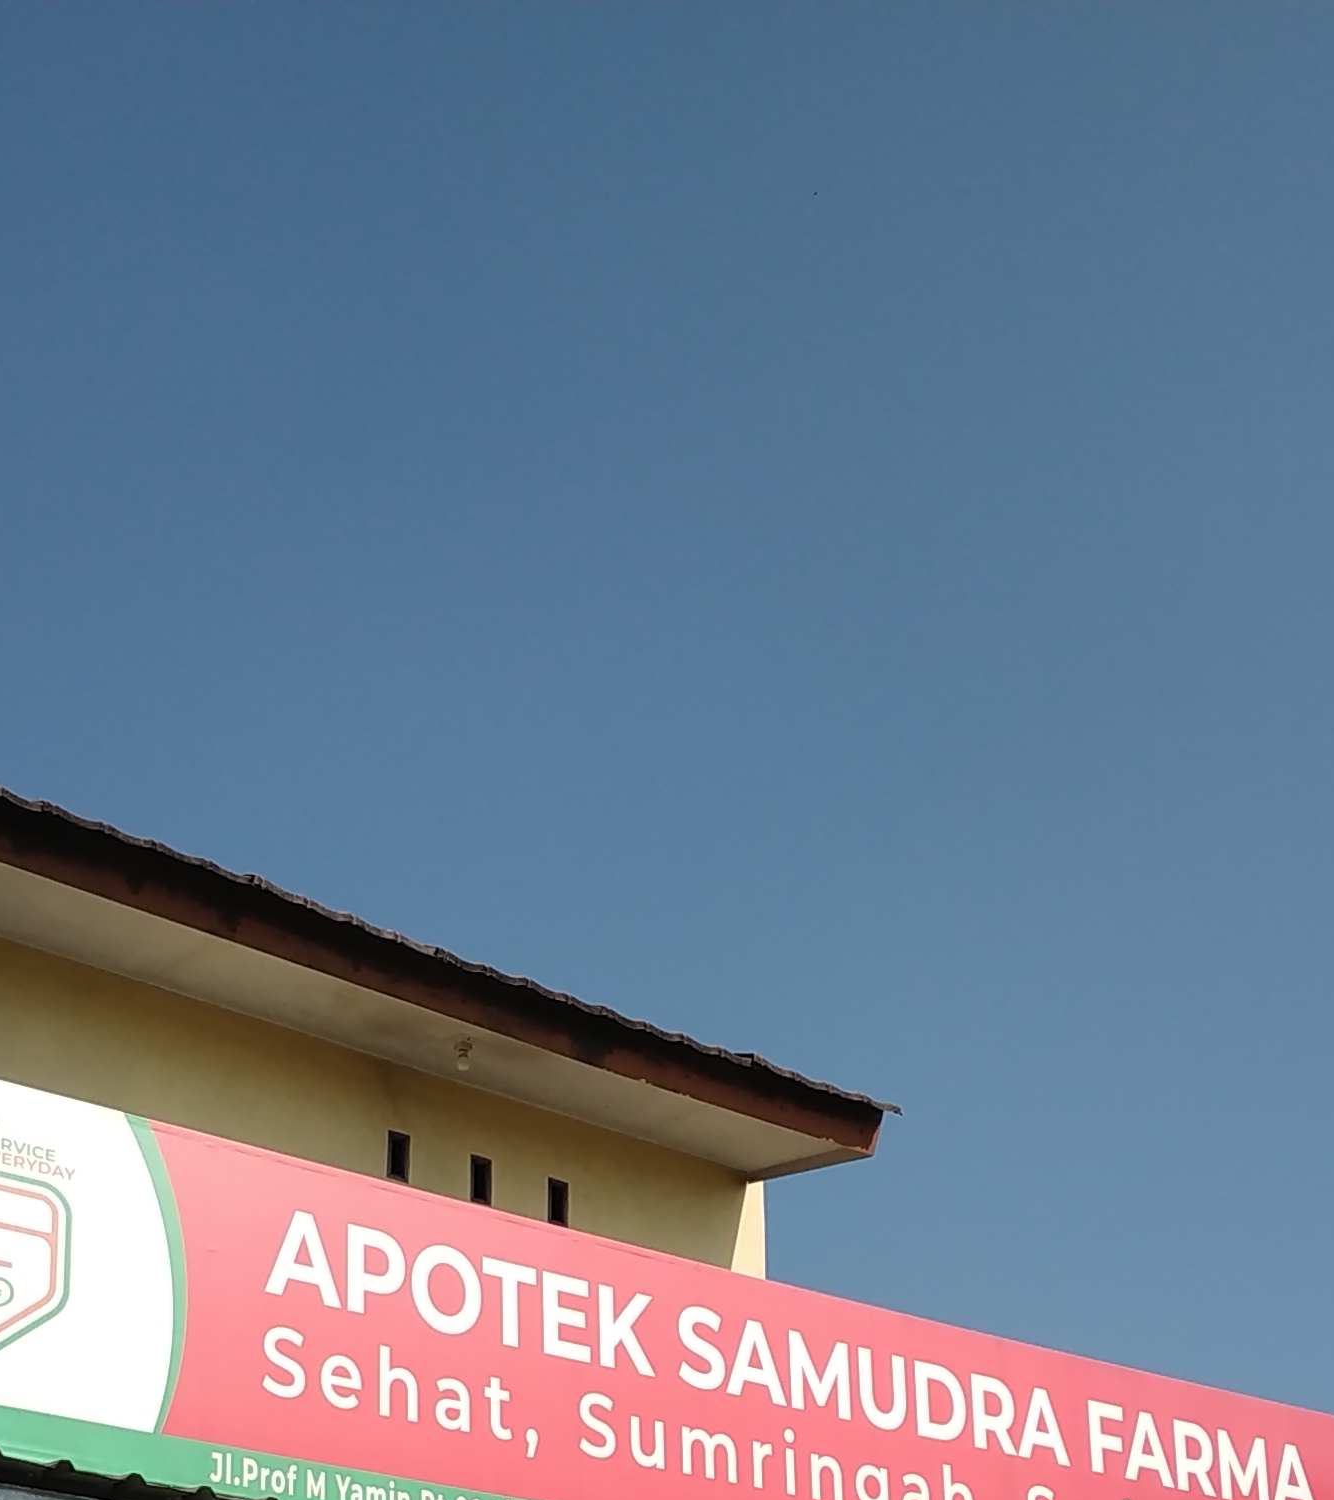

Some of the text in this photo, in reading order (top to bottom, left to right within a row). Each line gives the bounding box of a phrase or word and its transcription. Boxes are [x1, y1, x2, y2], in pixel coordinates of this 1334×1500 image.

[262, 1326, 540, 1459] Sehat,
[263, 1209, 657, 1379] APOTEK
[677, 1305, 1071, 1468] SAMUDRA
[209, 1450, 297, 1498] Jl.Prof
[305, 1472, 327, 1500] M
